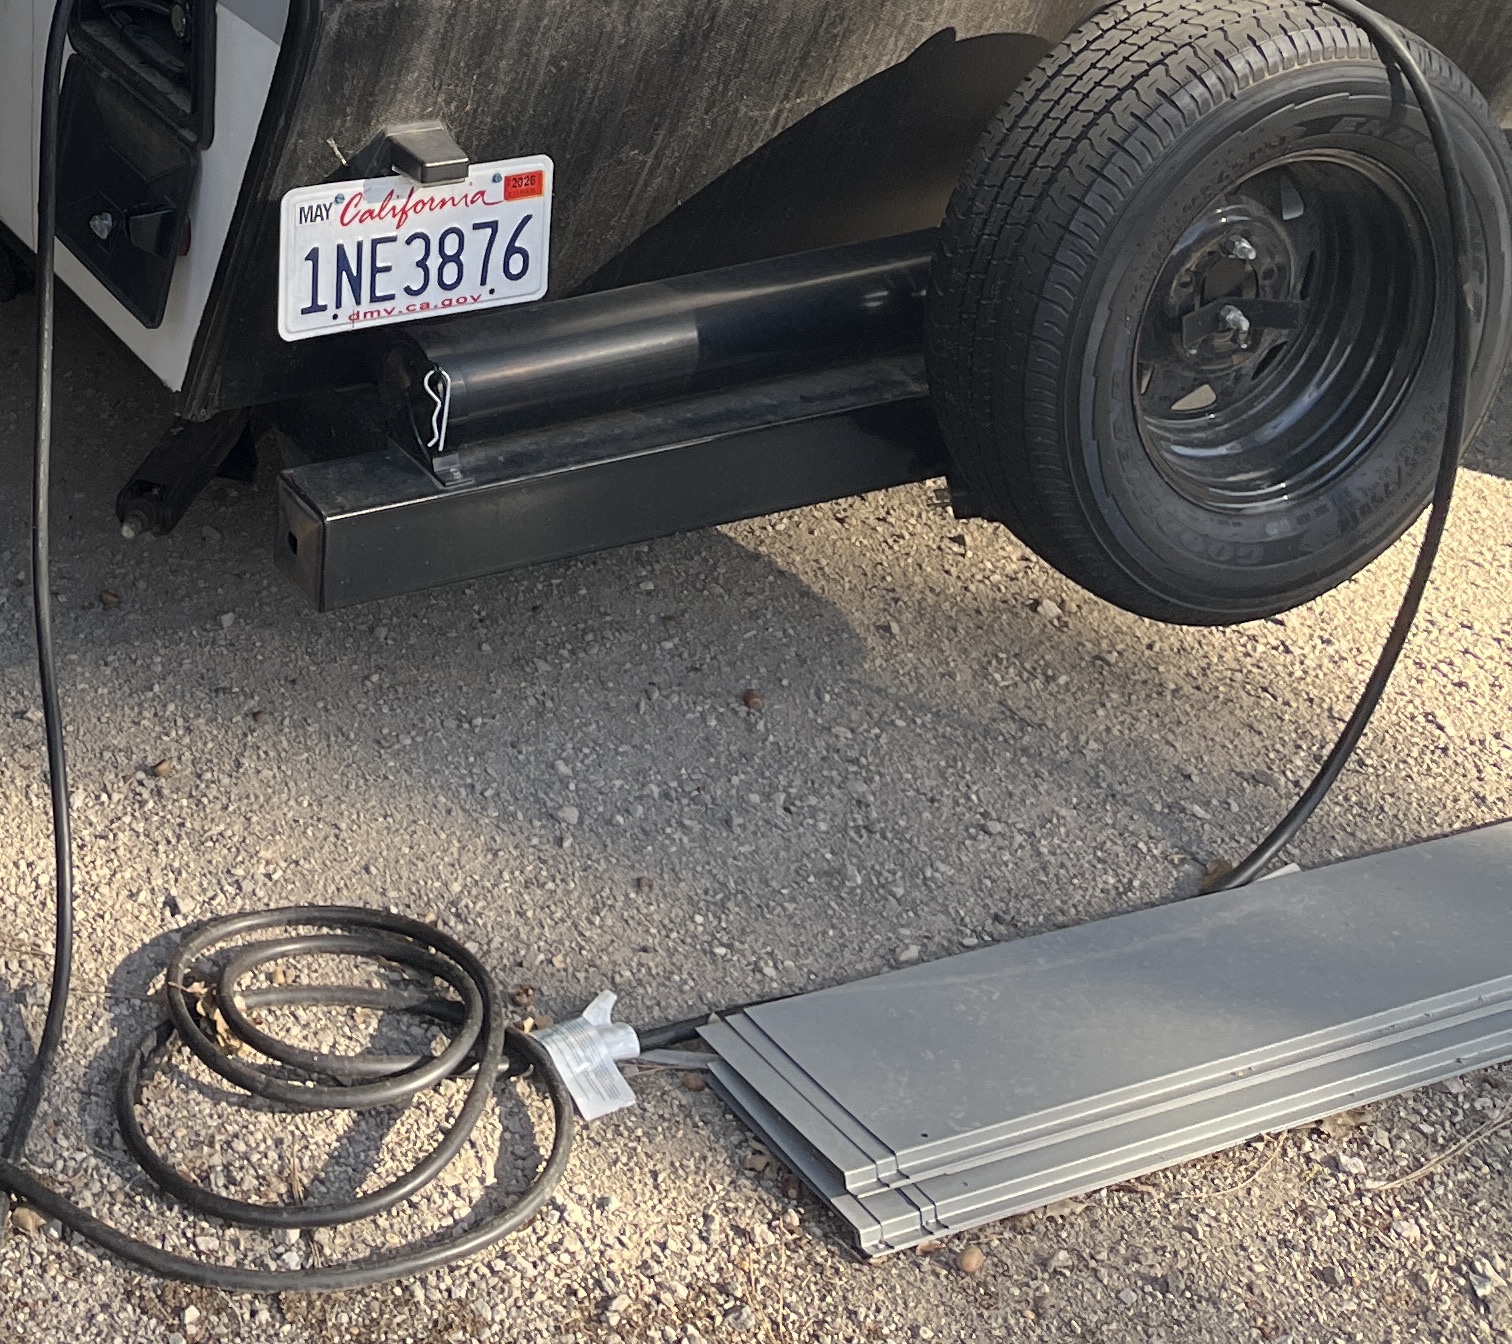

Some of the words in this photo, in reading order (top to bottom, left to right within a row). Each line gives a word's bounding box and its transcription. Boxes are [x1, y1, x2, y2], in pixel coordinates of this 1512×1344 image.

[511, 174, 537, 189] 2026
[299, 202, 333, 225] MAY
[340, 183, 503, 230] California
[301, 214, 533, 316] 1NE3876
[348, 294, 482, 323] dmv.ca.gov
